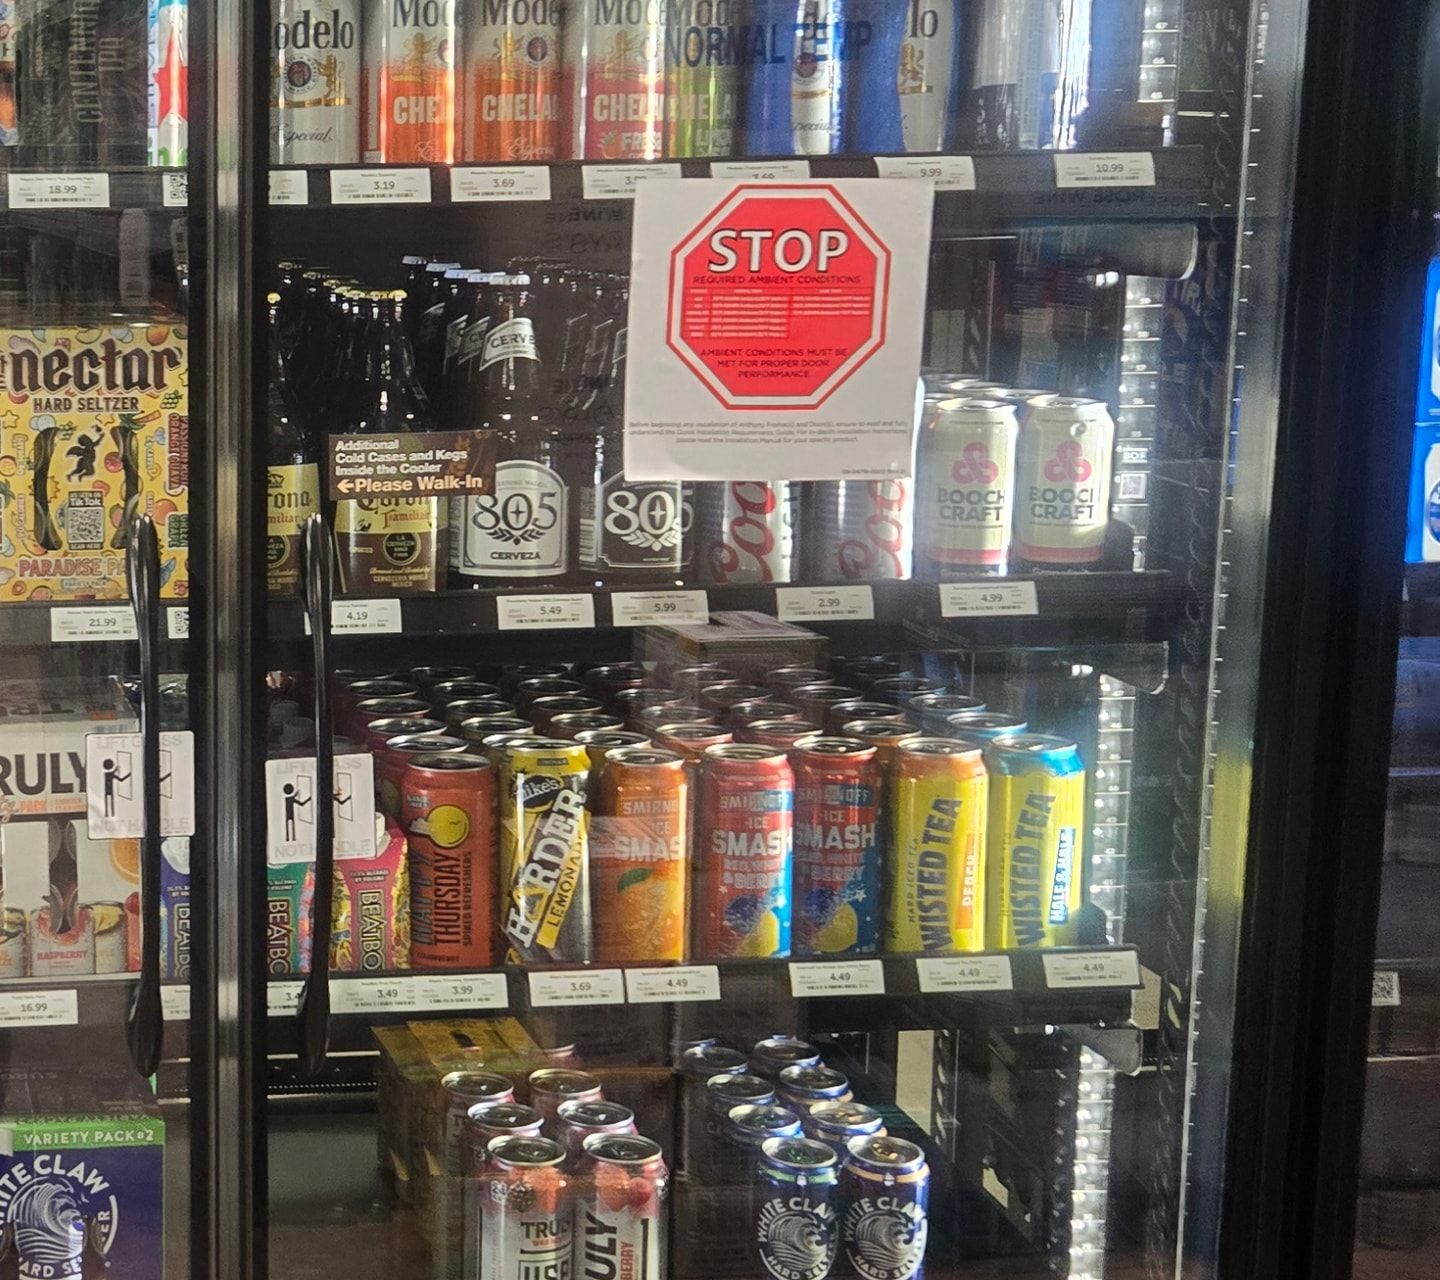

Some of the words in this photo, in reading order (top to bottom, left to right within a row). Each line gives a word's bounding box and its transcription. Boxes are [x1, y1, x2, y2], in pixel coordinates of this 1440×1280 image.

[271, 9, 354, 51] odelo
[48, 184, 78, 195] 18.99
[373, 180, 396, 191] 3.19
[708, 227, 850, 274] STOP
[11, 342, 184, 395] nectar
[34, 398, 71, 413] HARD
[77, 397, 139, 412] SELTZER
[335, 439, 399, 452] Additional
[335, 452, 365, 464] Cold
[368, 451, 405, 464] Cases
[409, 450, 433, 462] and
[435, 449, 468, 463] Kegs
[335, 464, 367, 476] Inside
[370, 463, 390, 475] the
[393, 462, 442, 475] Cooler
[354, 477, 413, 493] Please
[418, 474, 483, 492] Walk-In
[473, 492, 558, 530] 805
[938, 505, 1004, 521] CRAFT
[490, 551, 541, 561] CERVEZA
[19, 557, 102, 578] PARADISE
[653, 602, 677, 613] 5.99
[818, 597, 841, 608] 2.99
[346, 611, 369, 621] 4.19
[539, 605, 563, 616] 5.49
[824, 810, 845, 822] ICE
[931, 796, 964, 842] TEA
[509, 787, 586, 948] HARDER
[433, 850, 461, 947] THURSDAY
[36, 950, 88, 961] RASPBERRY
[829, 972, 851, 982] 4.49
[377, 988, 399, 999] 3.49
[451, 985, 474, 996] 3.99
[20, 1002, 48, 1013] 16.99
[23, 1130, 89, 1146] VARIETY
[33, 1153, 110, 1195] CLAW
[619, 1241, 635, 1280] BERRY
